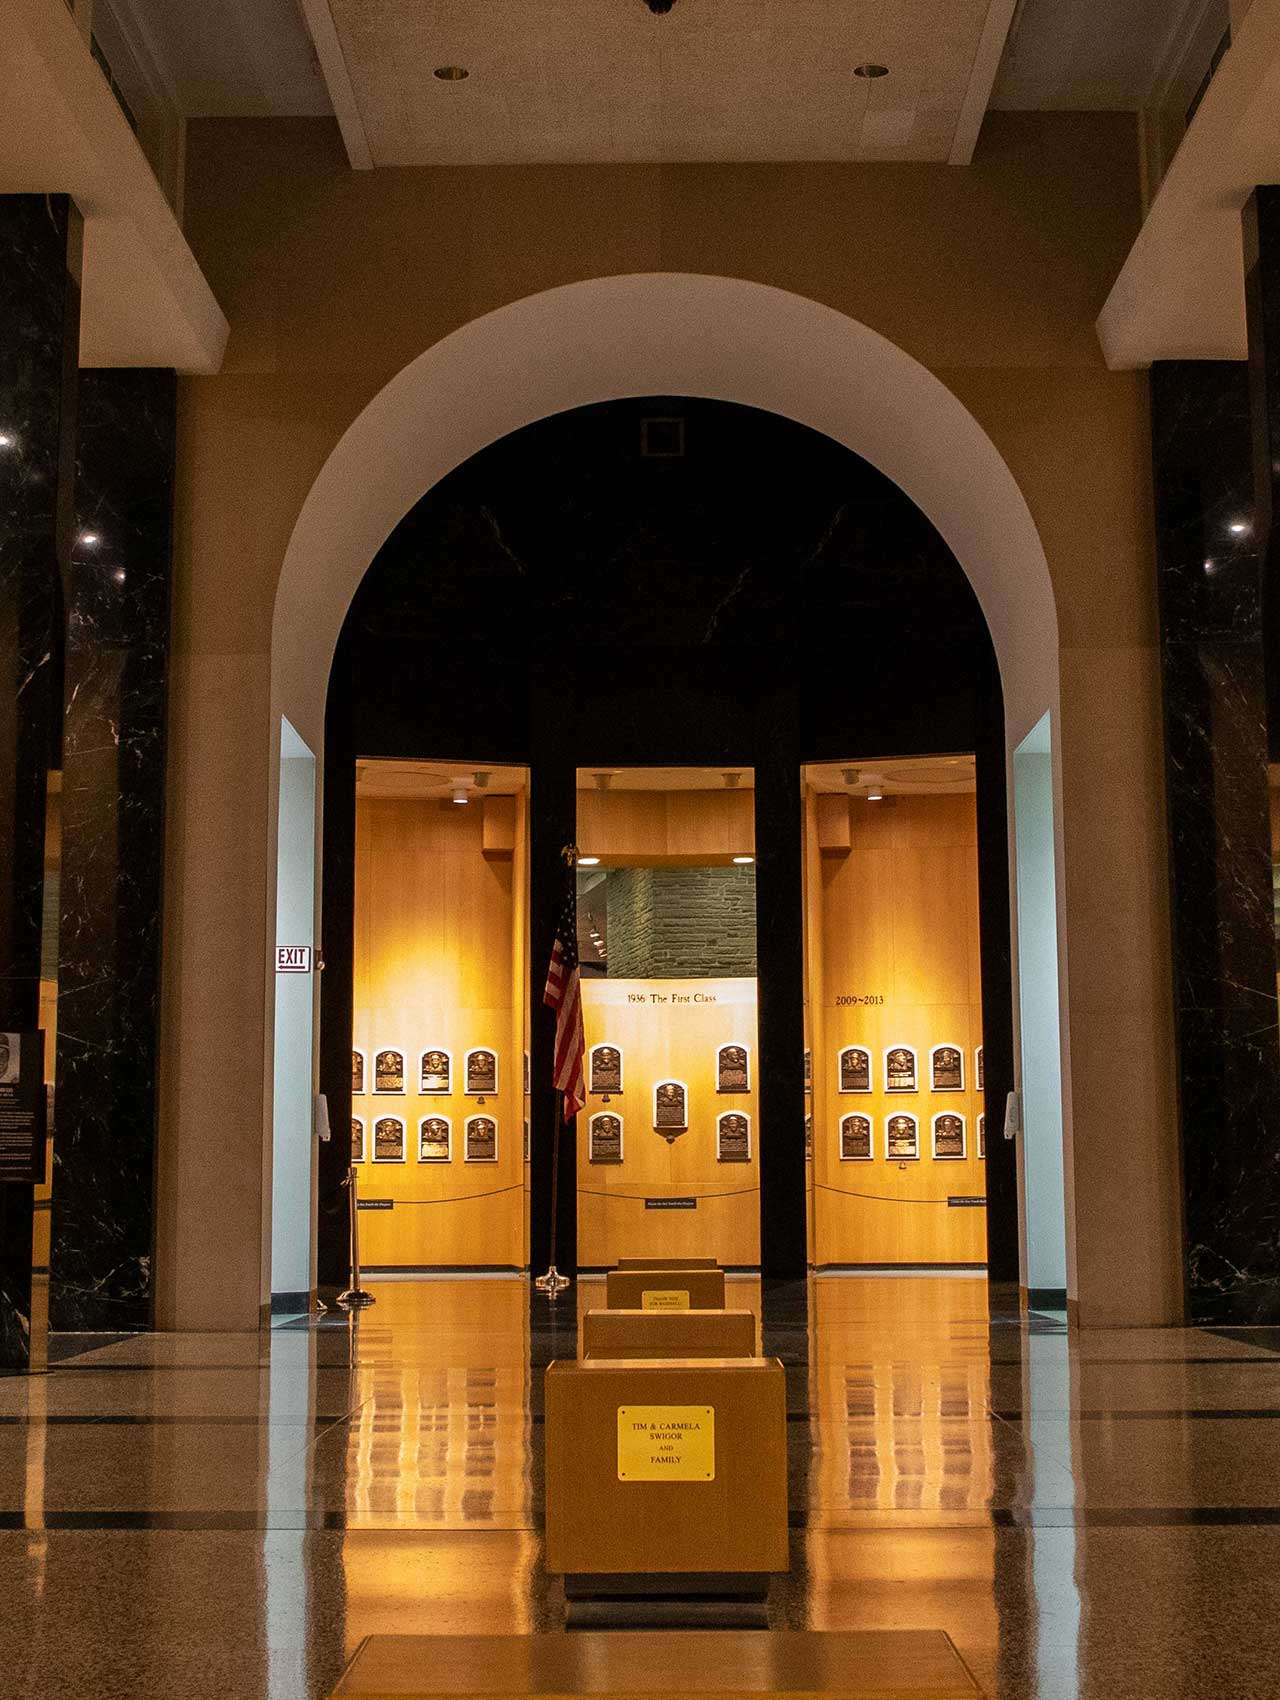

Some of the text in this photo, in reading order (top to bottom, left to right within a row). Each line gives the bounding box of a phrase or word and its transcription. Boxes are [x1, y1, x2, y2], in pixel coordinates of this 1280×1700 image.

[278, 948, 305, 964] EXIT
[627, 993, 717, 1003] 1936 The First Class
[632, 1423, 648, 1431] TIM
[649, 1432, 683, 1440] SWIGOR
[650, 1456, 682, 1464] FAMILY
